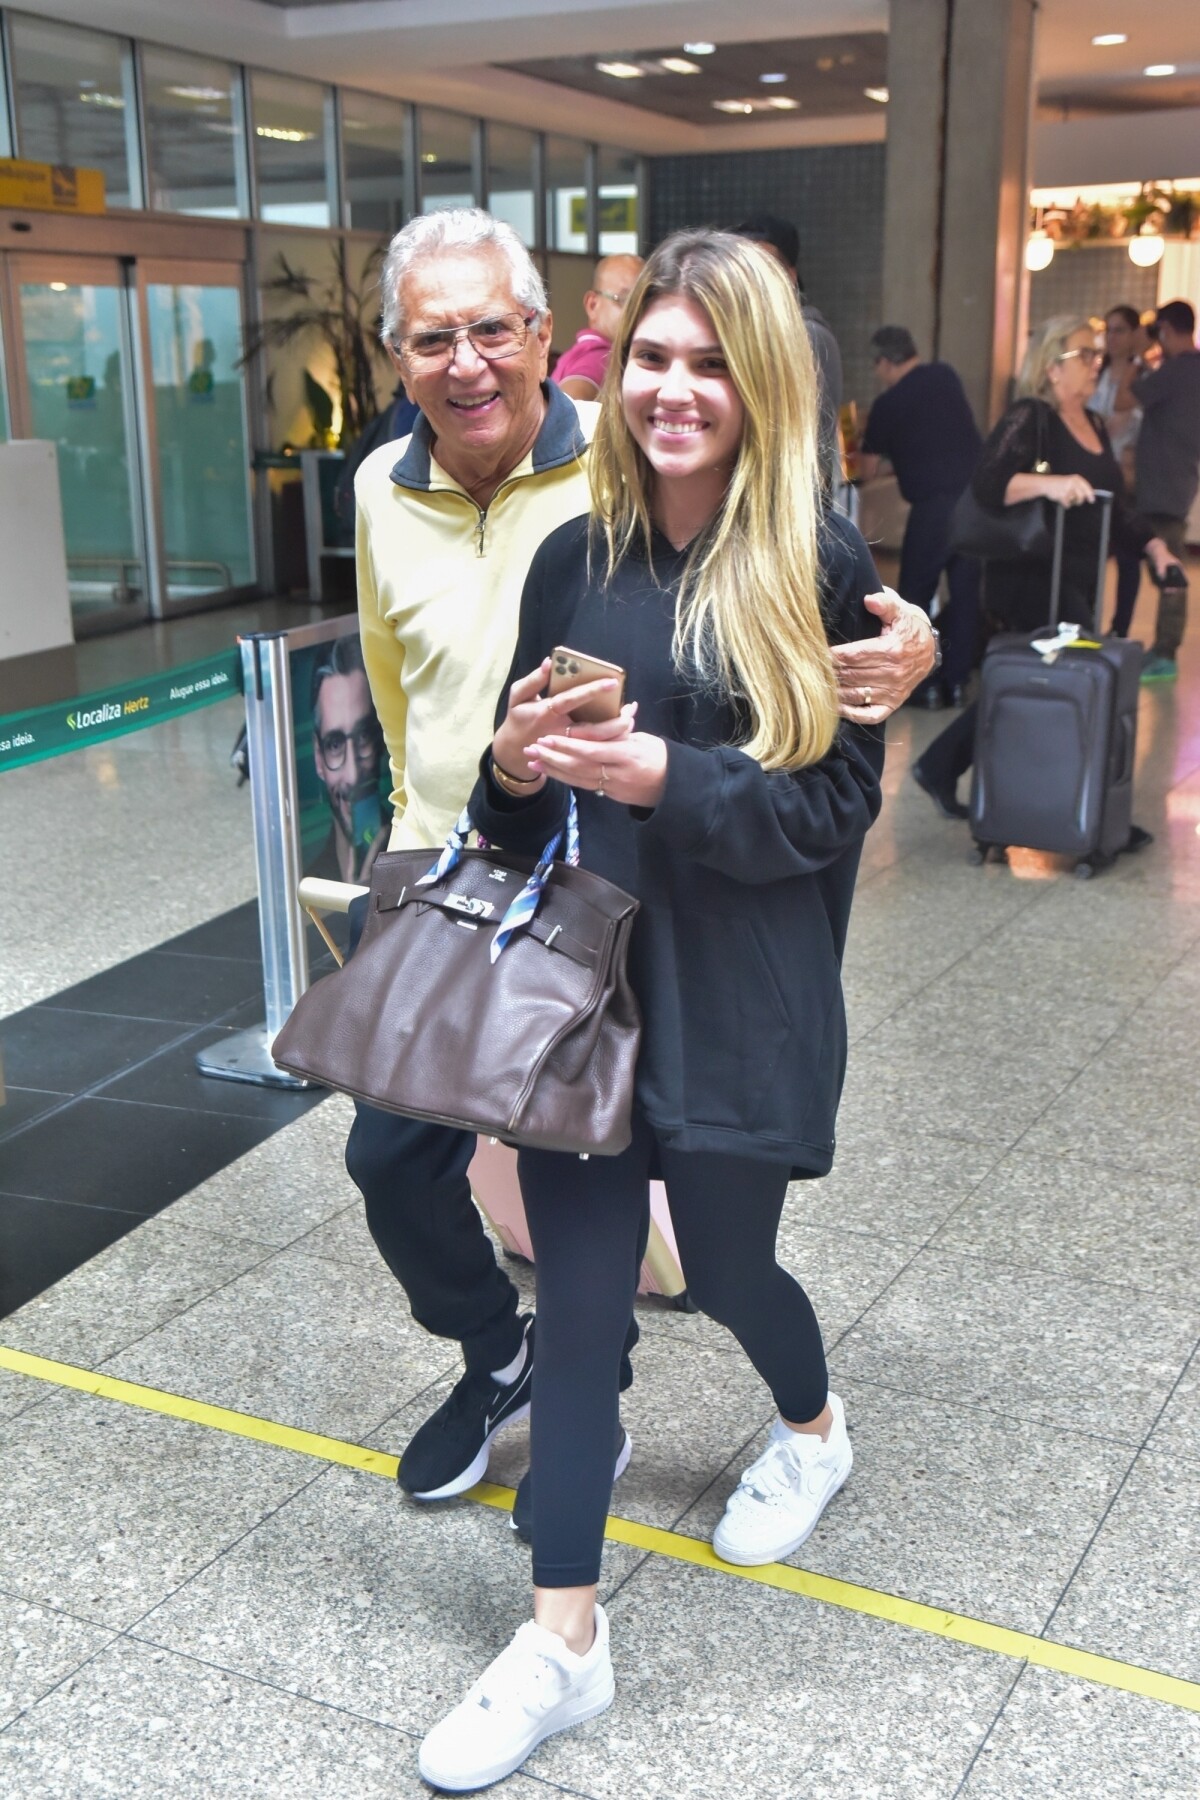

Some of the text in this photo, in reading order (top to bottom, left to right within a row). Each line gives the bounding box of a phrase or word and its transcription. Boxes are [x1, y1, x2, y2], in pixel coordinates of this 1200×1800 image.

[170, 686, 194, 700] Alugue
[195, 679, 211, 692] essa
[77, 697, 149, 729] Localiza Hertz
[12, 732, 35, 748] ideia.
